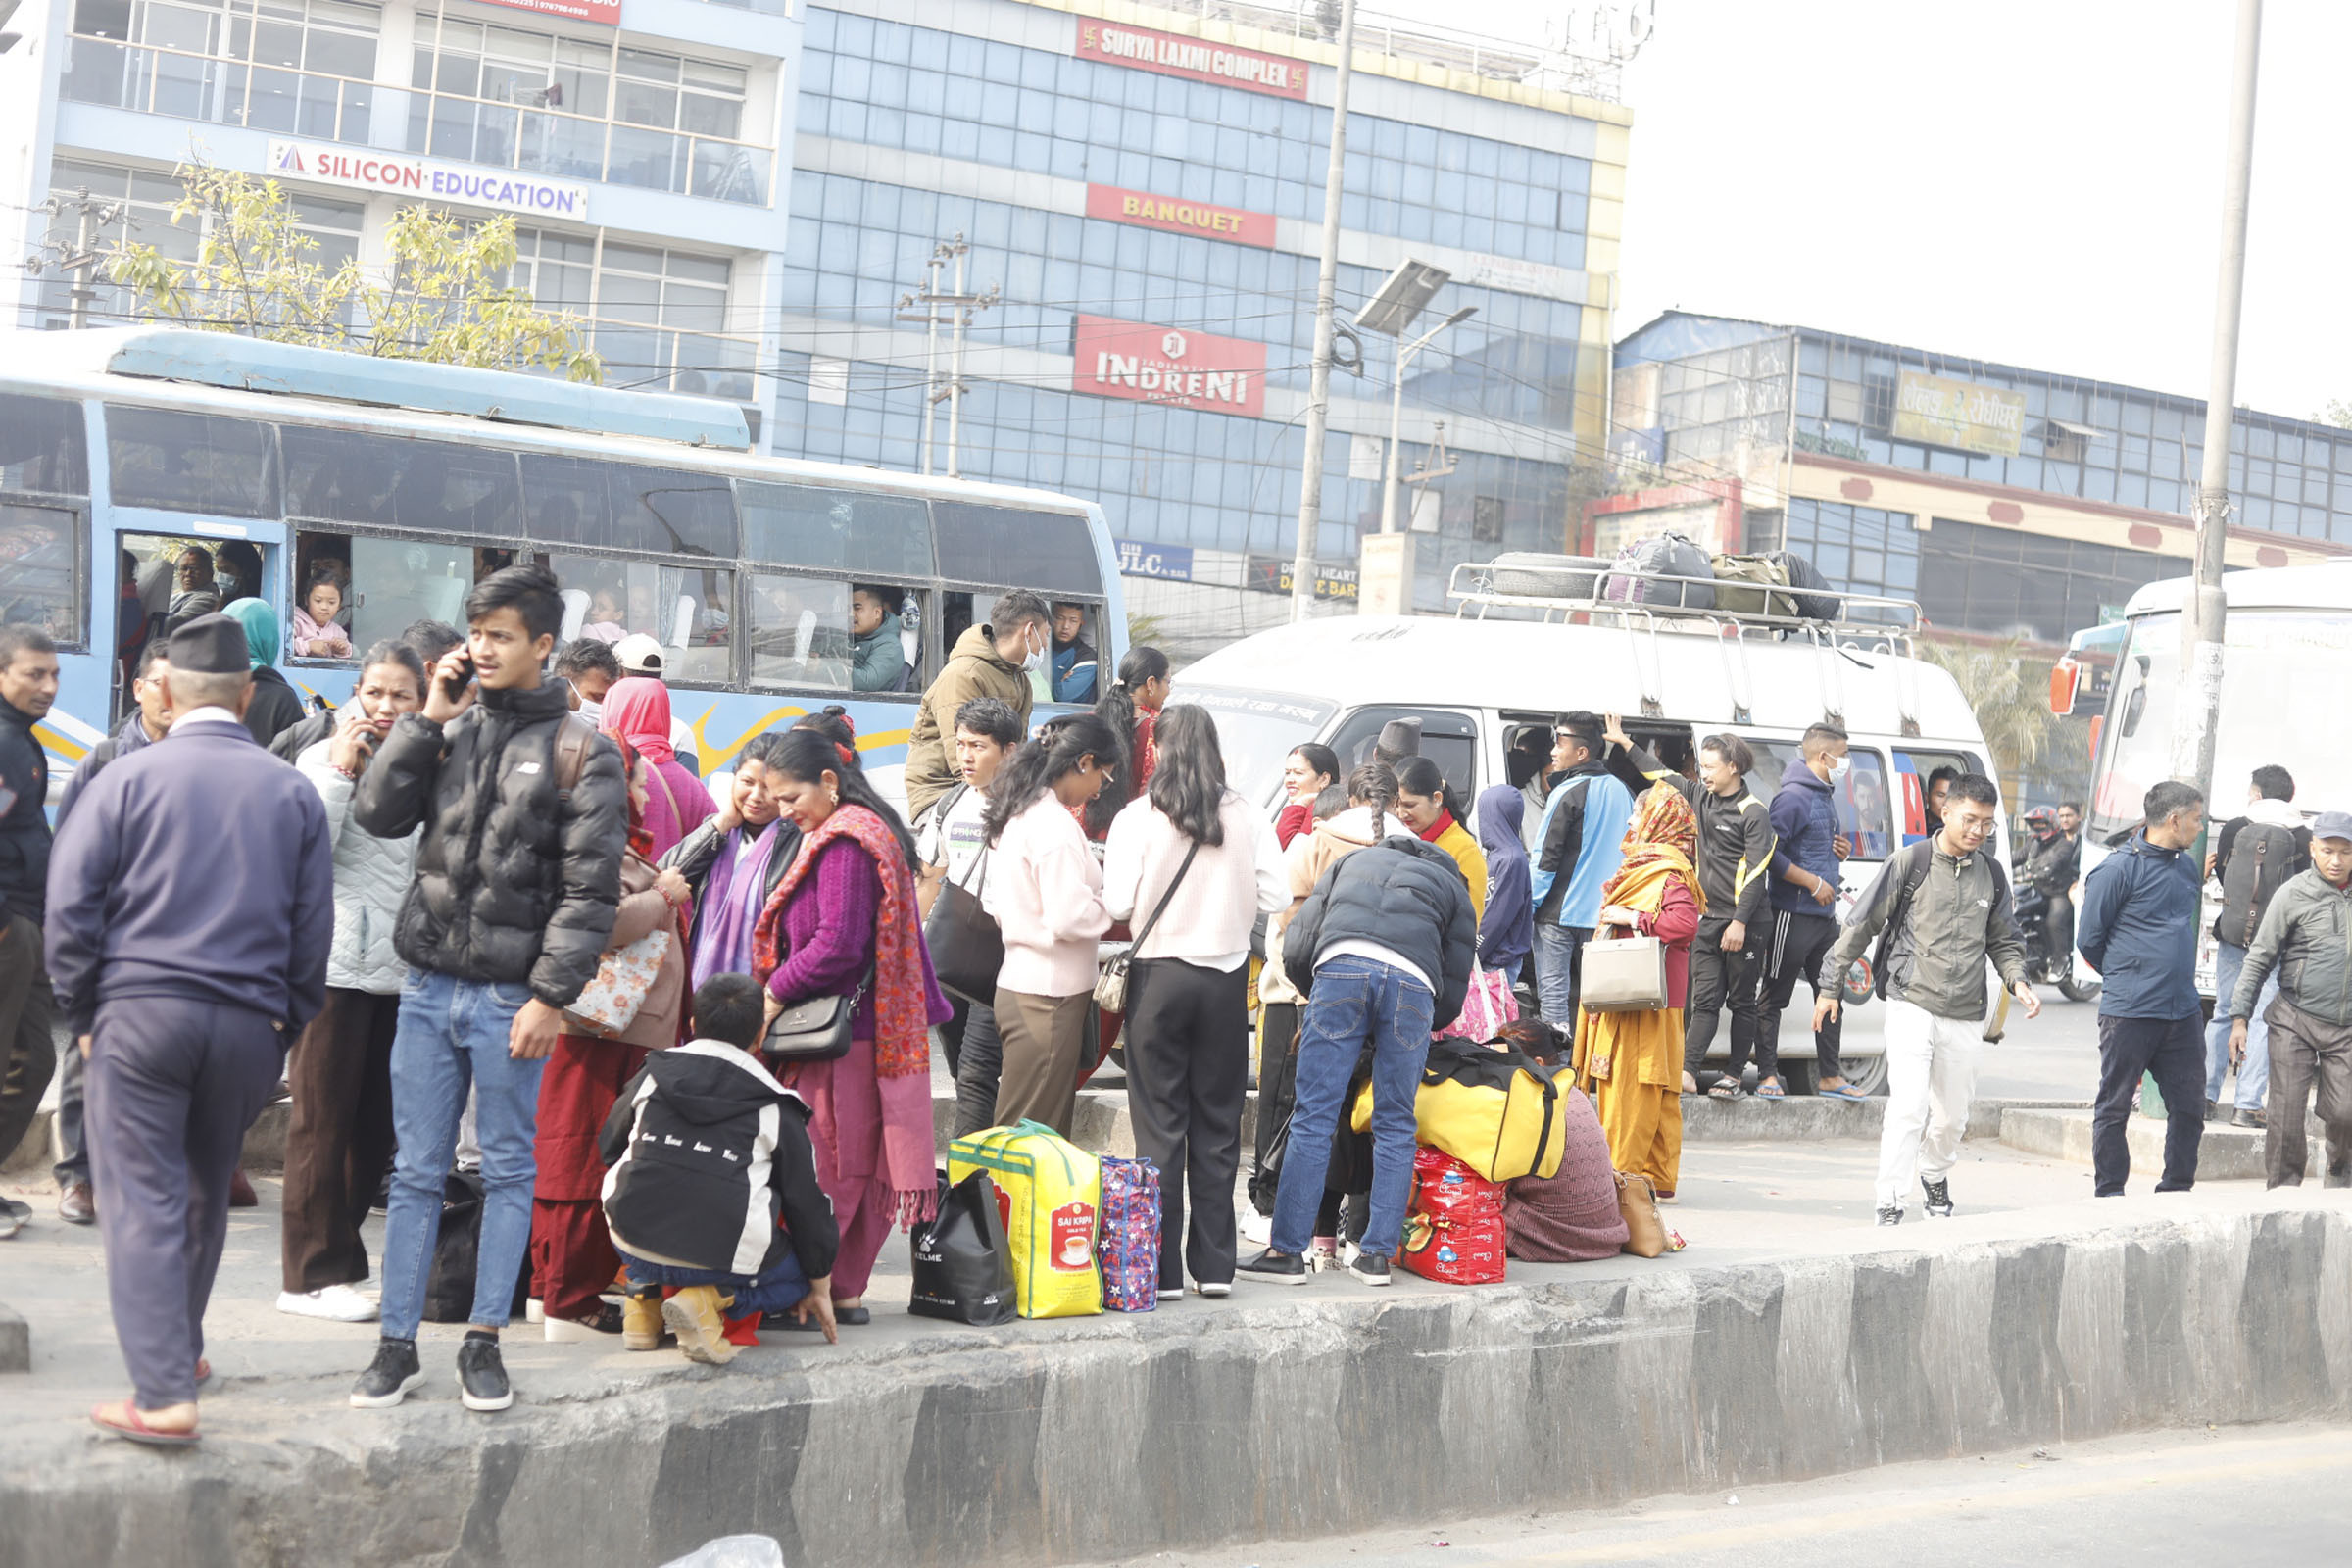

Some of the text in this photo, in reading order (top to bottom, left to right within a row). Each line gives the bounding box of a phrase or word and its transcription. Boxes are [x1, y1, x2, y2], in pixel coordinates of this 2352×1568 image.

[1101, 28, 1288, 88] SURYA LAXMI COMPLEX
[318, 153, 576, 212] SILICON EDUCATION
[1123, 195, 1245, 233] BANQUET
[1096, 351, 1248, 404] INDRENI
[1280, 575, 1357, 597] DAE BAR
[1321, 567, 1357, 582] HEART
[1058, 1216, 1092, 1227] SAI KRIPA
